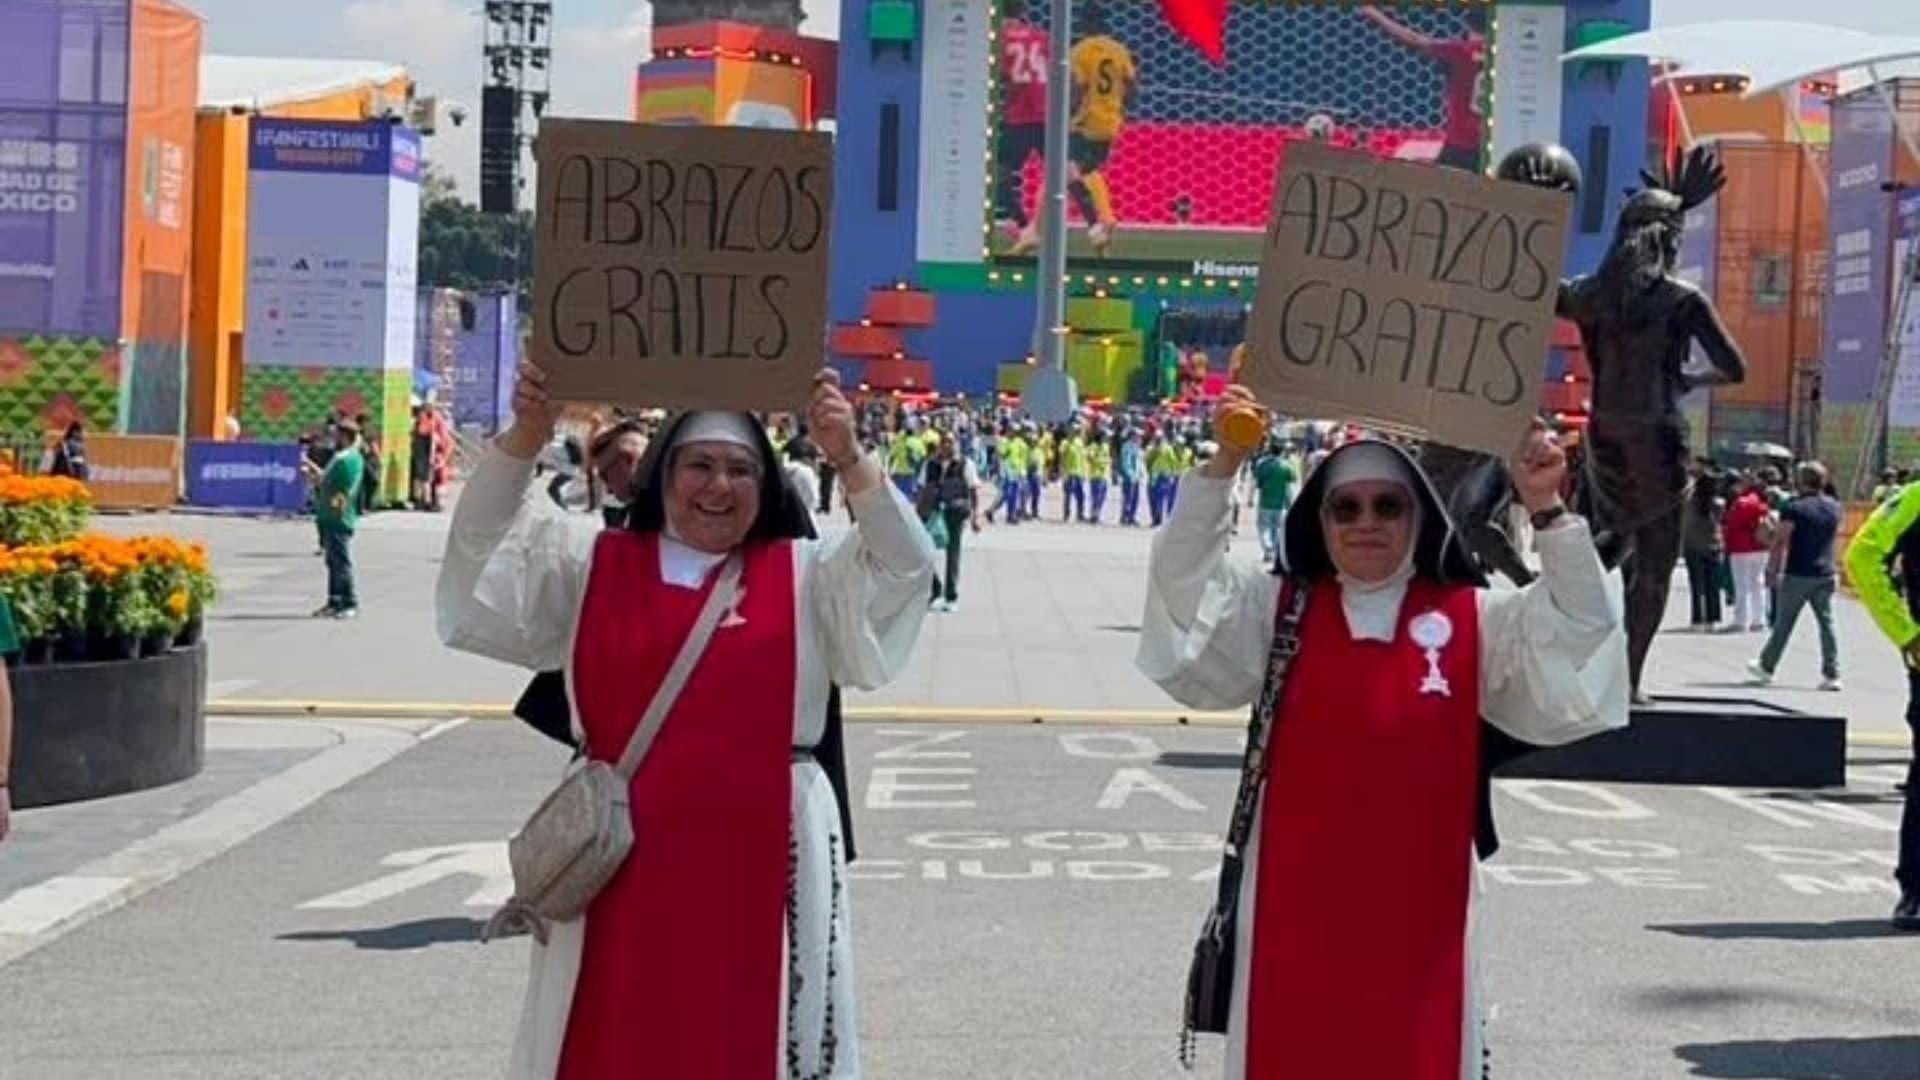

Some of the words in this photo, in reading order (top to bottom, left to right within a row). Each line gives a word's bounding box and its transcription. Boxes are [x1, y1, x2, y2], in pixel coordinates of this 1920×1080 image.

[1006, 41, 1048, 83] 24
[552, 154, 823, 252] ABRAZOS
[1274, 171, 1553, 301] ABRAZOS
[551, 266, 790, 361] GRATIS
[1280, 279, 1533, 405] GRATIS
